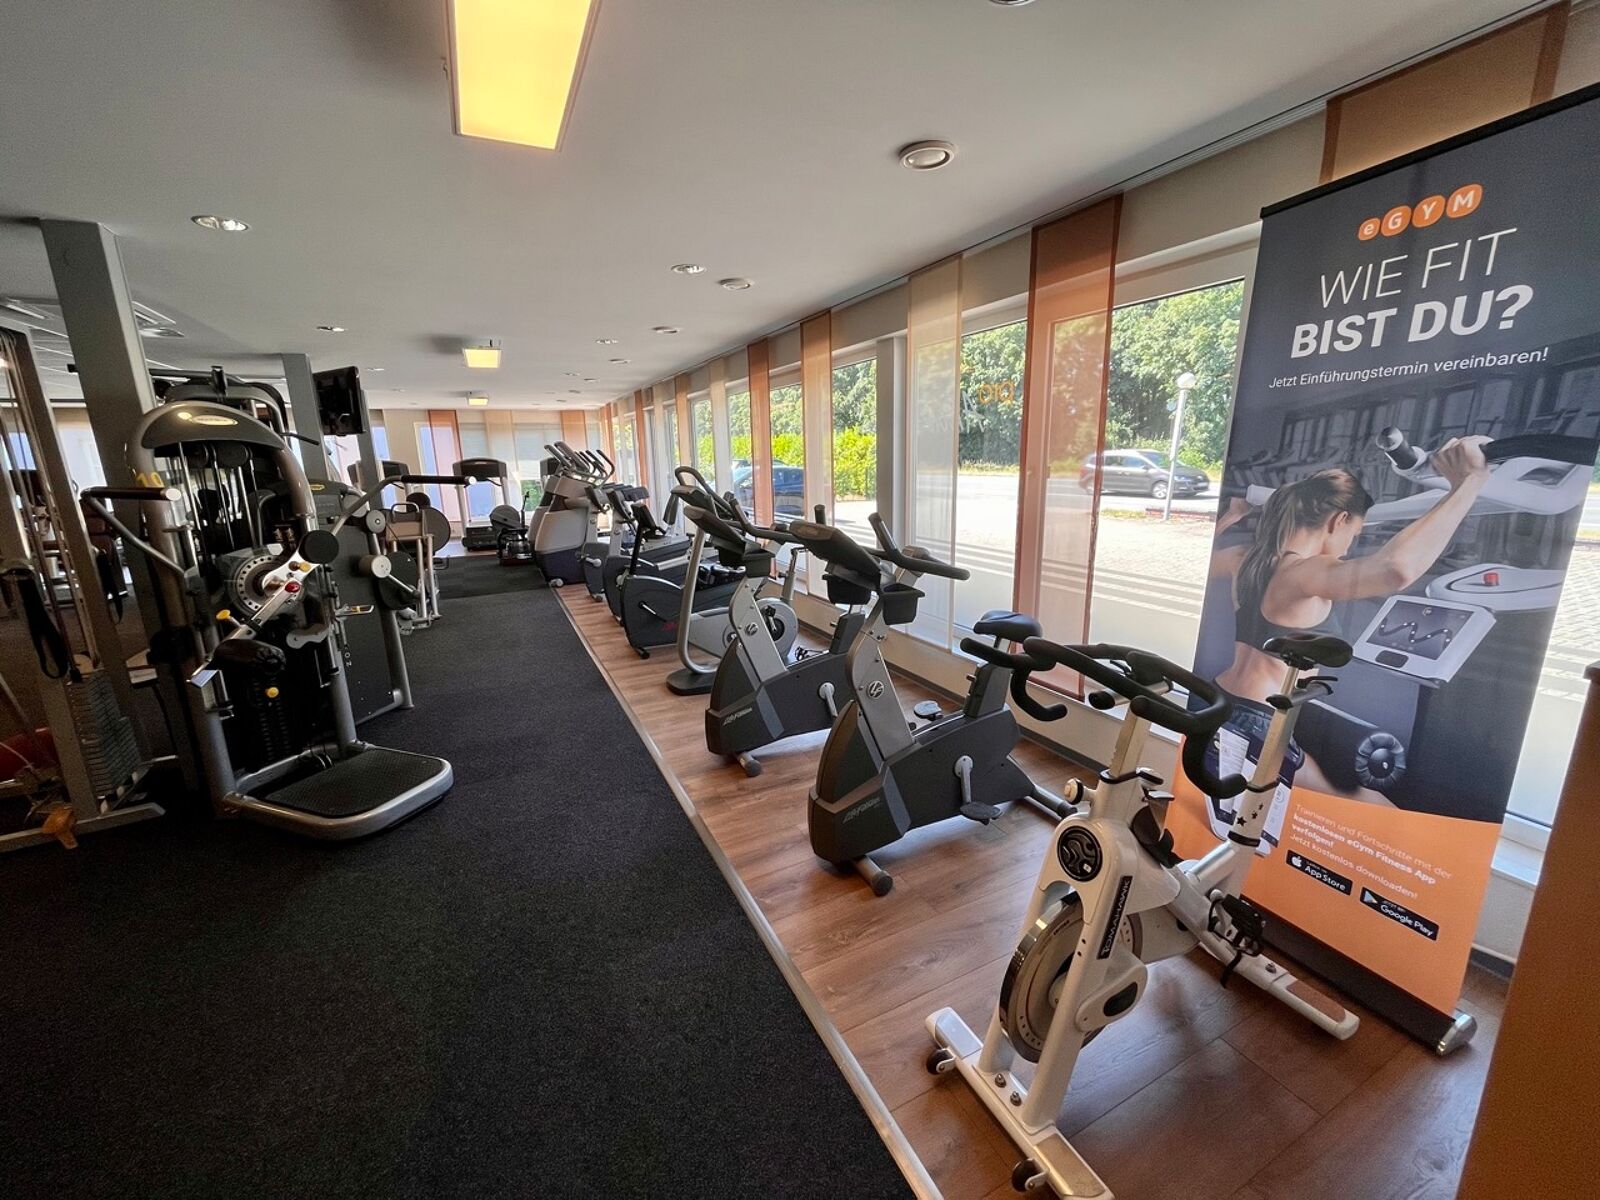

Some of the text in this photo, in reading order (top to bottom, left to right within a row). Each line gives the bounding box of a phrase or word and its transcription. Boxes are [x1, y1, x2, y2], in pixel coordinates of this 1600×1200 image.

[1360, 188, 1478, 237] eGYM
[1321, 228, 1517, 308] WIE FIT
[1291, 284, 1534, 358] BIST DU?
[1269, 347, 1549, 389] Jetzt Einführungstermin vereinbaren!
[1304, 865, 1323, 879] App
[1323, 874, 1347, 891] Store
[1375, 850, 1413, 874] Fitness
[1414, 869, 1437, 885] App
[1380, 903, 1414, 927] Google
[1414, 919, 1435, 937] Play
